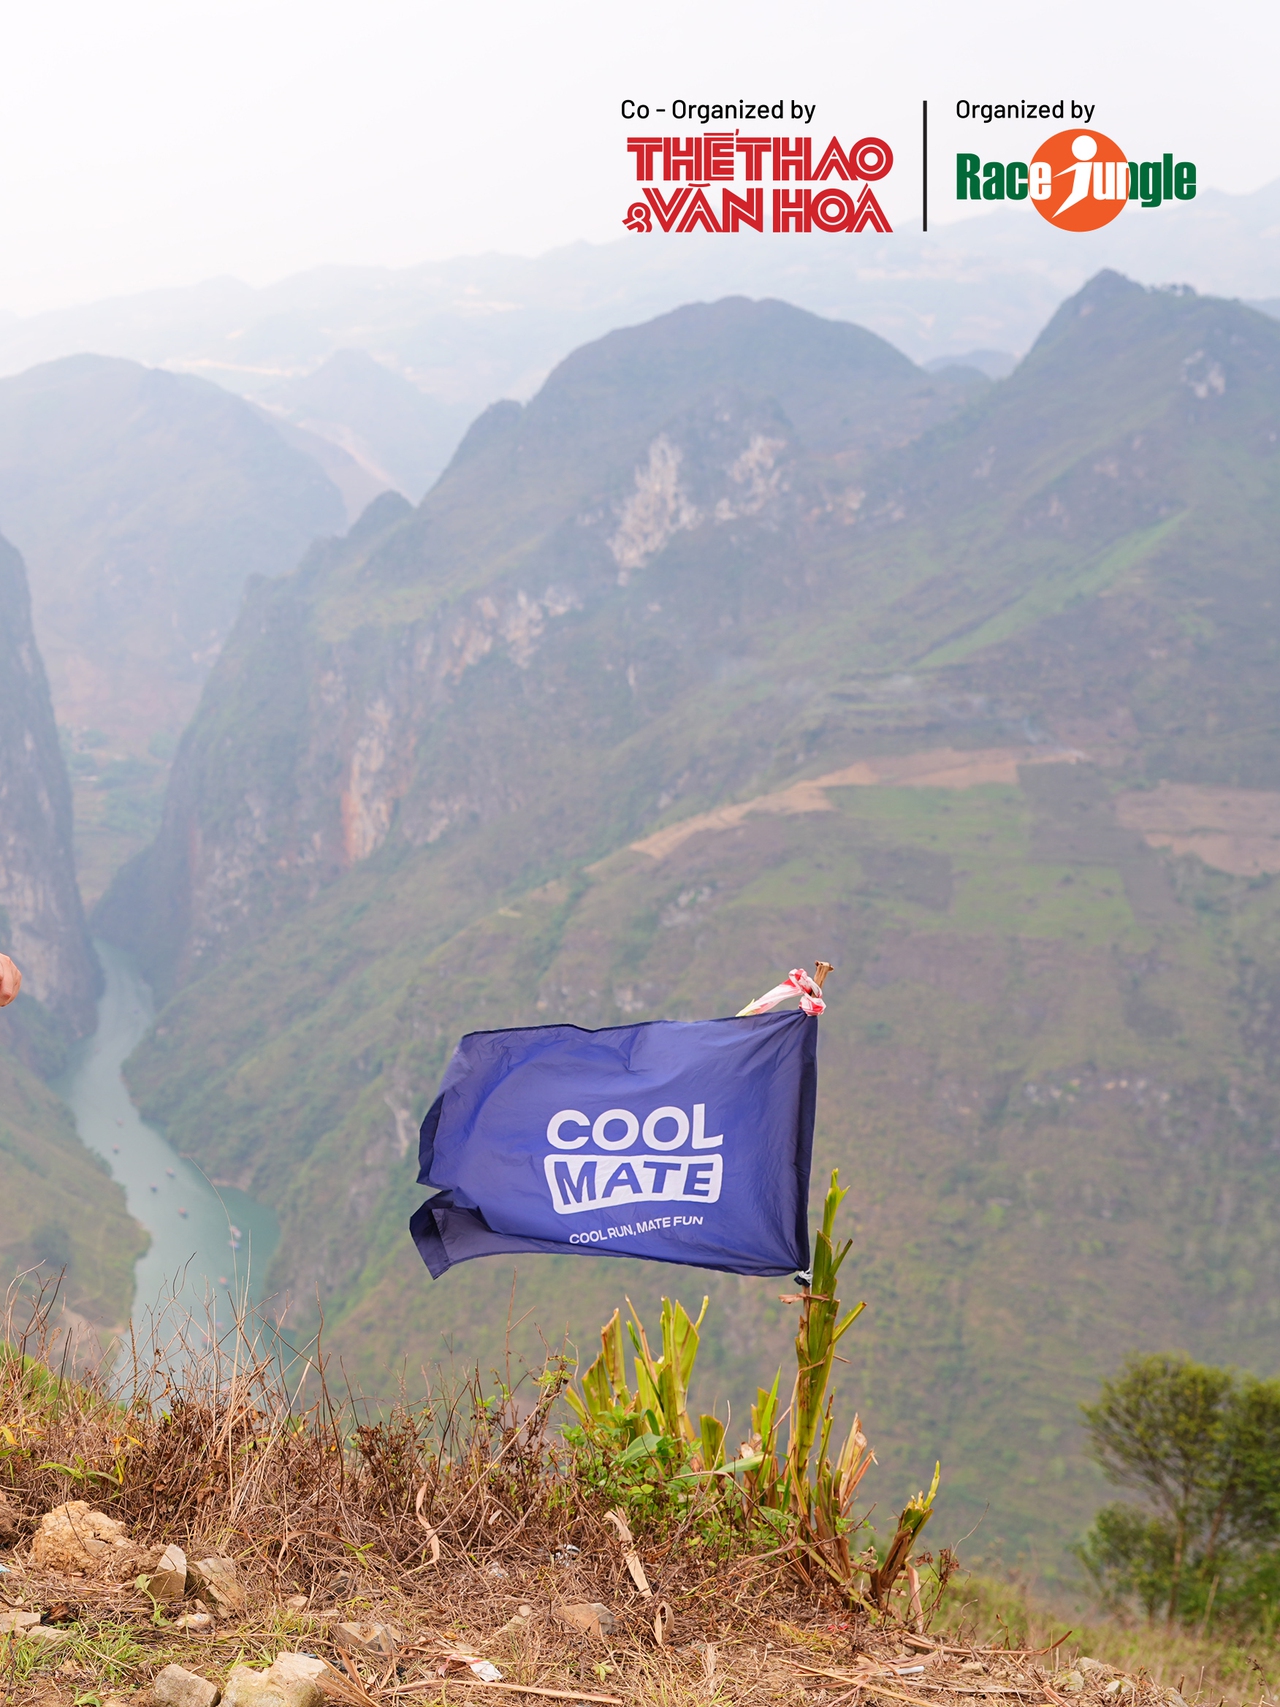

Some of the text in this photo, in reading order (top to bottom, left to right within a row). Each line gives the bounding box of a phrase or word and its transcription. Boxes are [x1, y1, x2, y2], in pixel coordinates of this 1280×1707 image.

[546, 1103, 723, 1151] COOL
[554, 1161, 714, 1206] MATE
[569, 1216, 704, 1244] COOL RUN, MATE FUN
